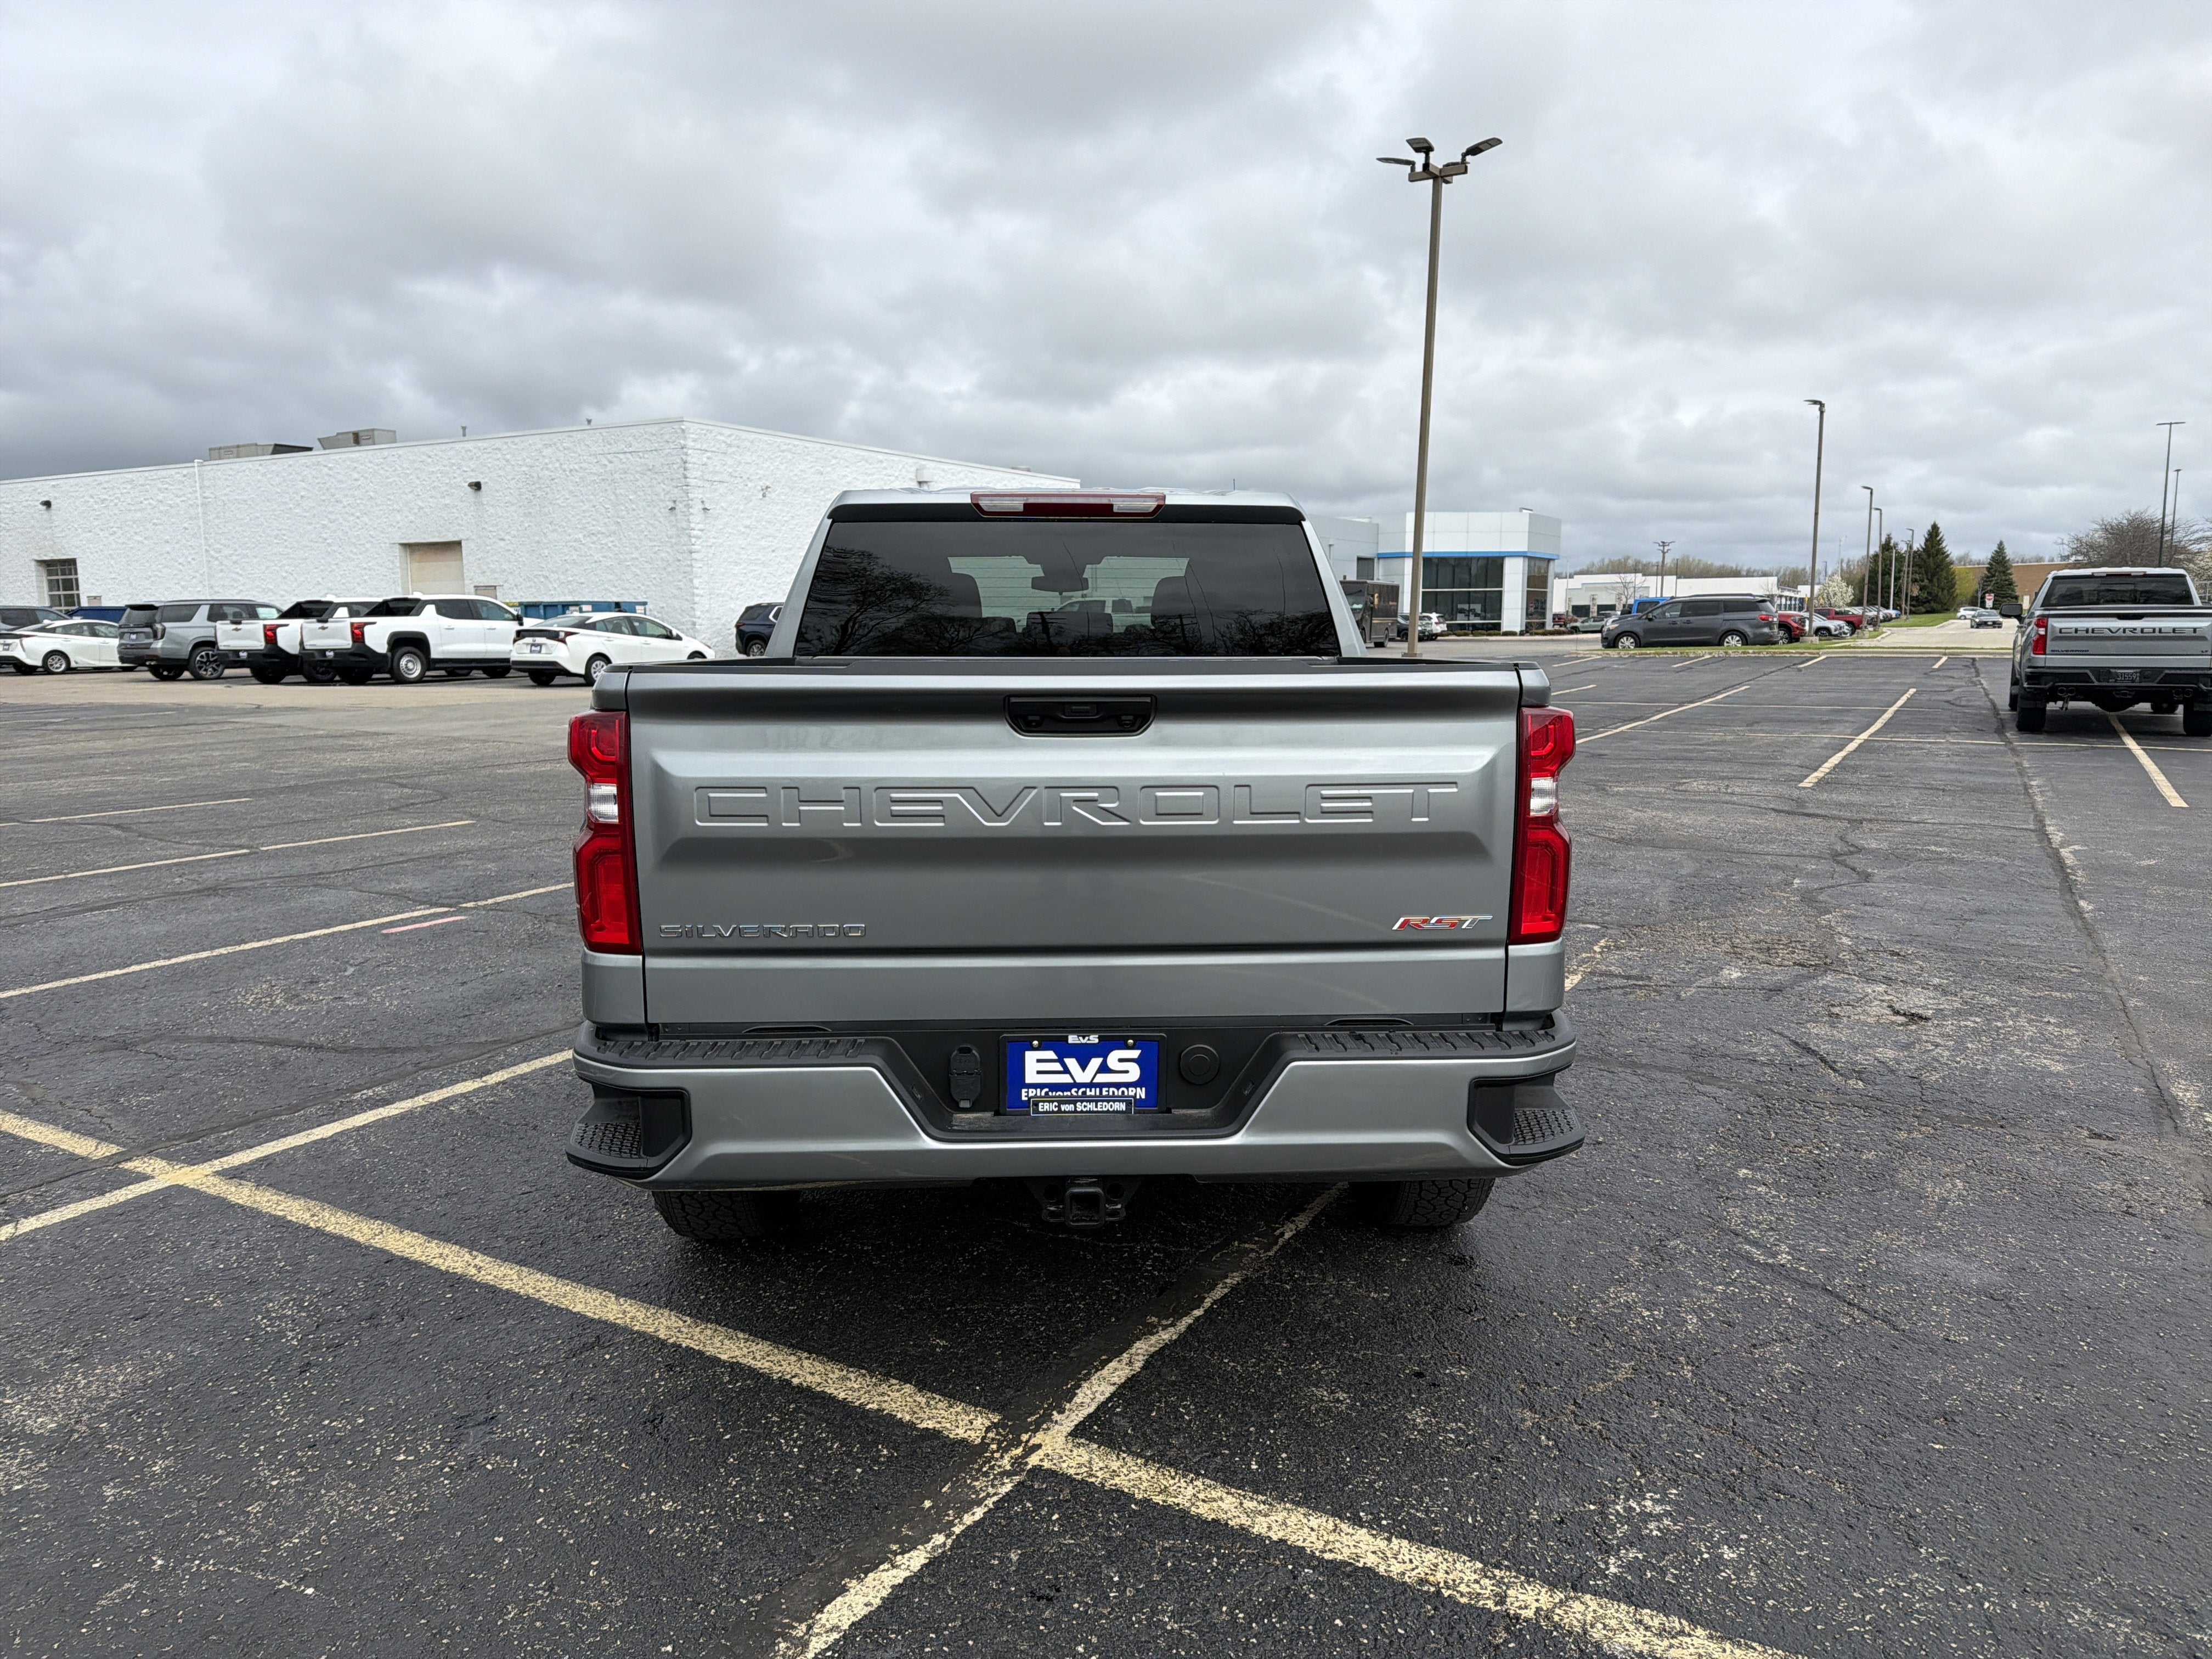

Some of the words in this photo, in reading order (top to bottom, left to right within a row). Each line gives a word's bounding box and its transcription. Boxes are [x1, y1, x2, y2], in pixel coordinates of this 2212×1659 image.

[694, 781, 1458, 827] CHEVROLET
[1392, 914, 1493, 930] RST
[659, 924, 867, 938] SILVERADO
[1039, 1102, 1058, 1111] ERIC
[1076, 1102, 1126, 1111] SCHLEDORN
